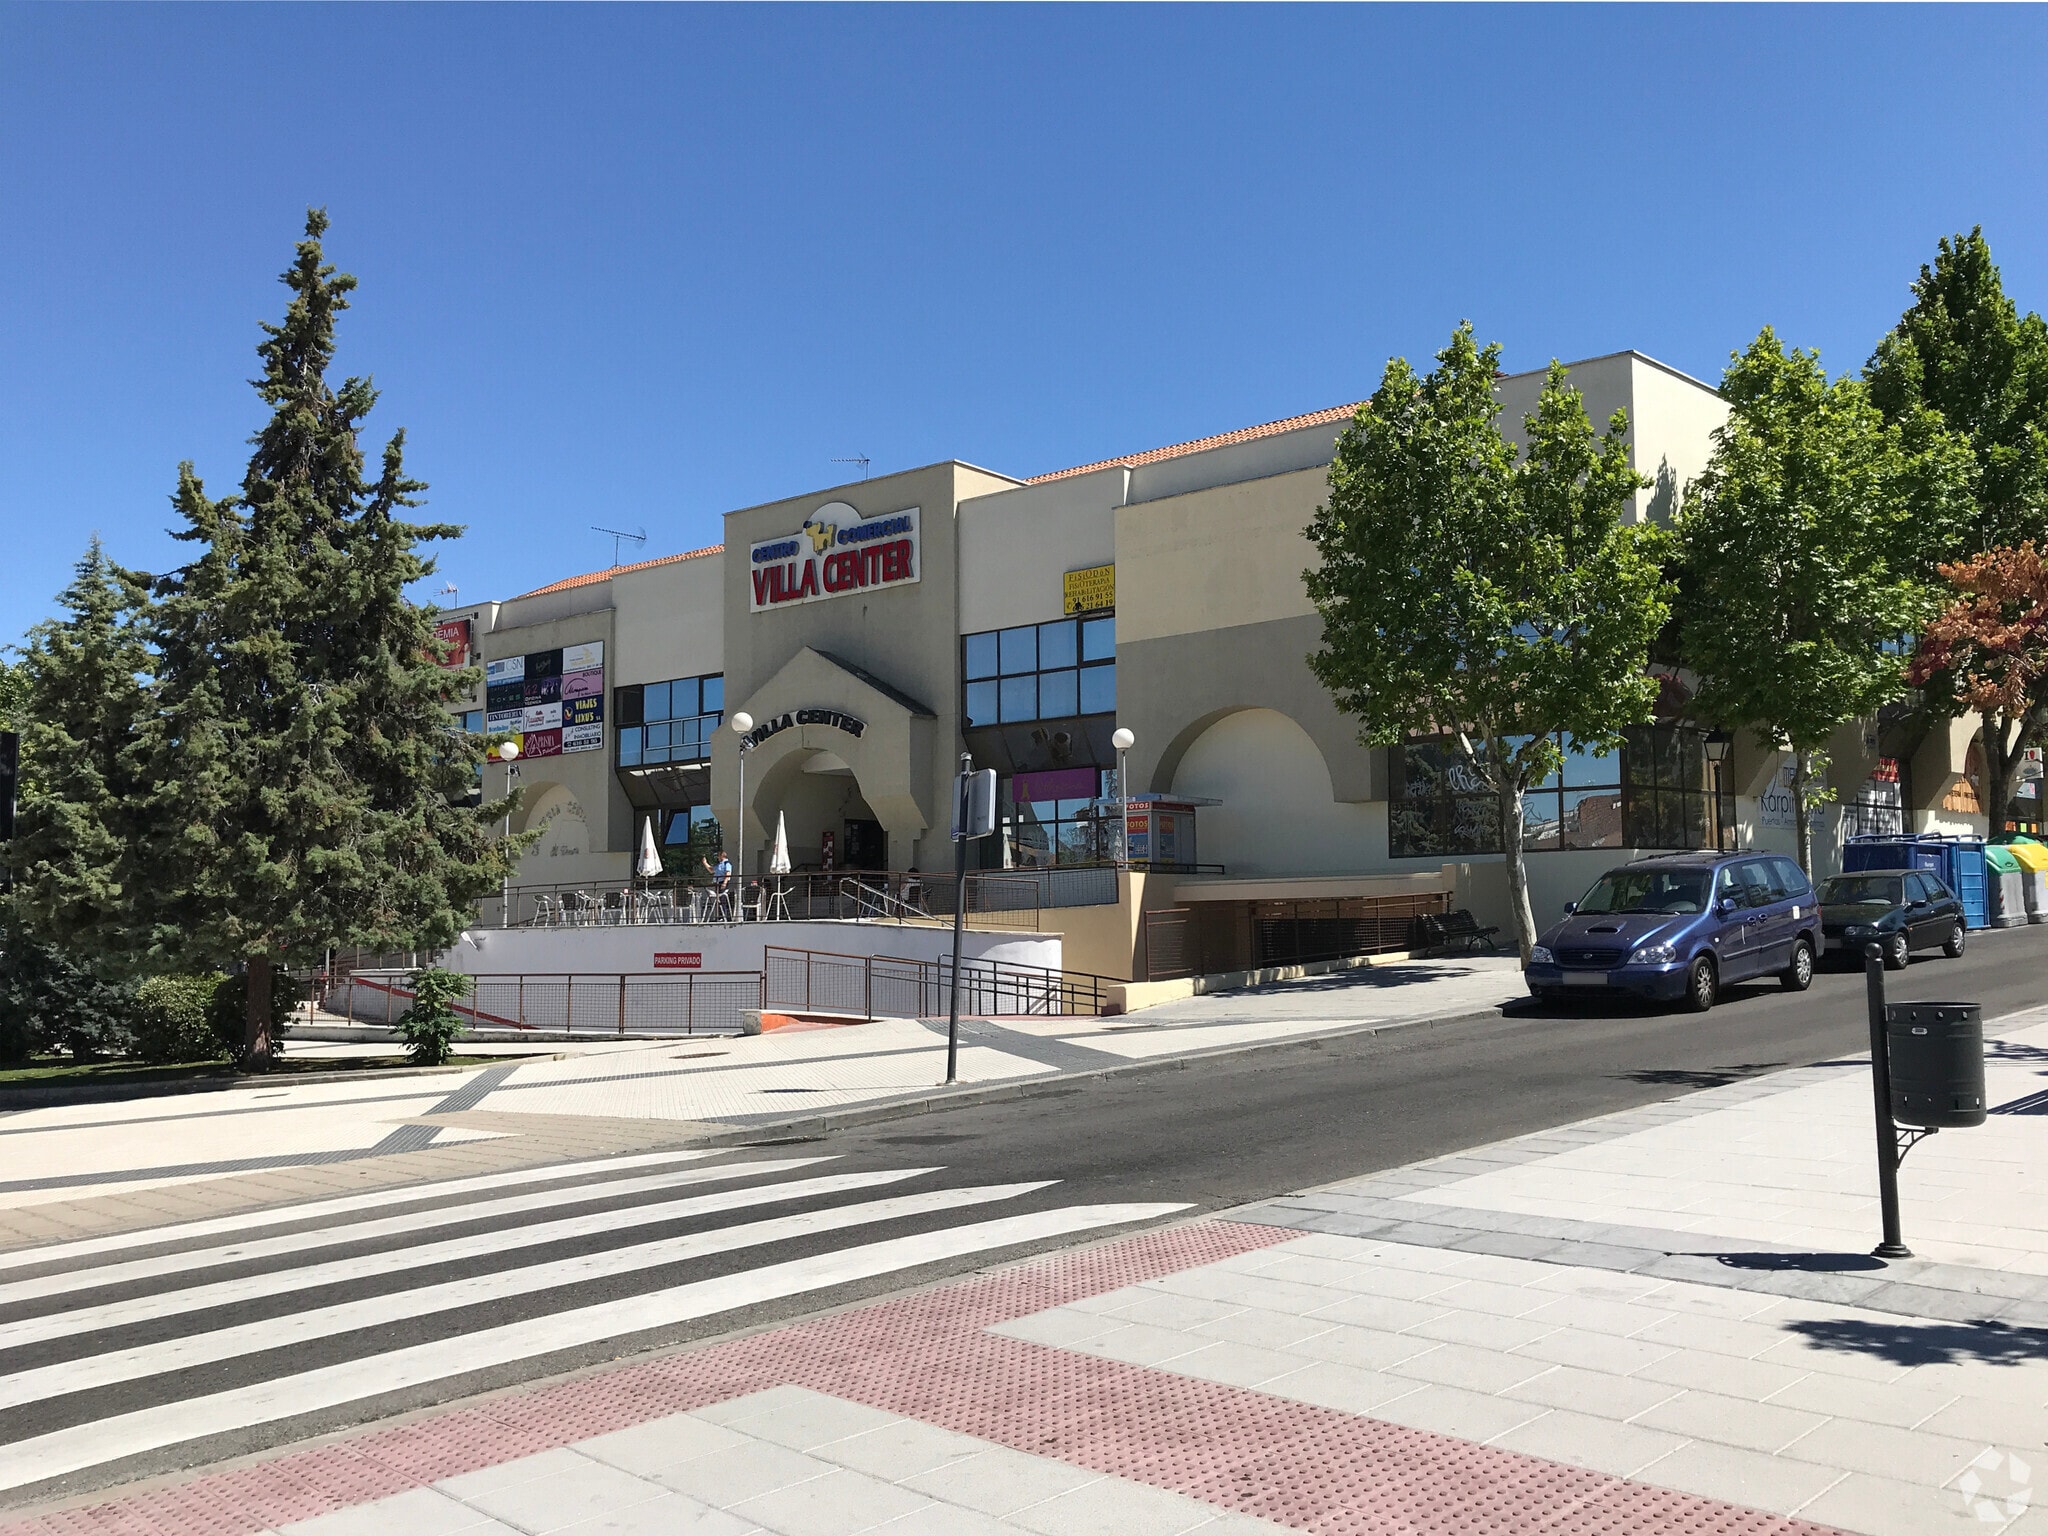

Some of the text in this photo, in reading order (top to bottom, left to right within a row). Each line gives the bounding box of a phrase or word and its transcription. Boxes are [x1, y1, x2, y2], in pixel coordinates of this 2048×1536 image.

[752, 516, 913, 563] CENTRO COMERCIAL
[752, 539, 913, 605] VILLA CENTER
[1082, 594, 1094, 602] 616
[1095, 592, 1103, 600] 91
[1105, 591, 1113, 599] 55
[575, 698, 597, 710] VIAJES
[575, 712, 594, 724] LIXUS
[575, 723, 601, 732] CONSULTING
[744, 709, 865, 747] VILLA CENTER
[573, 731, 602, 739] INMOBILIARIO
[654, 956, 701, 965] PARKING PRIVADO
